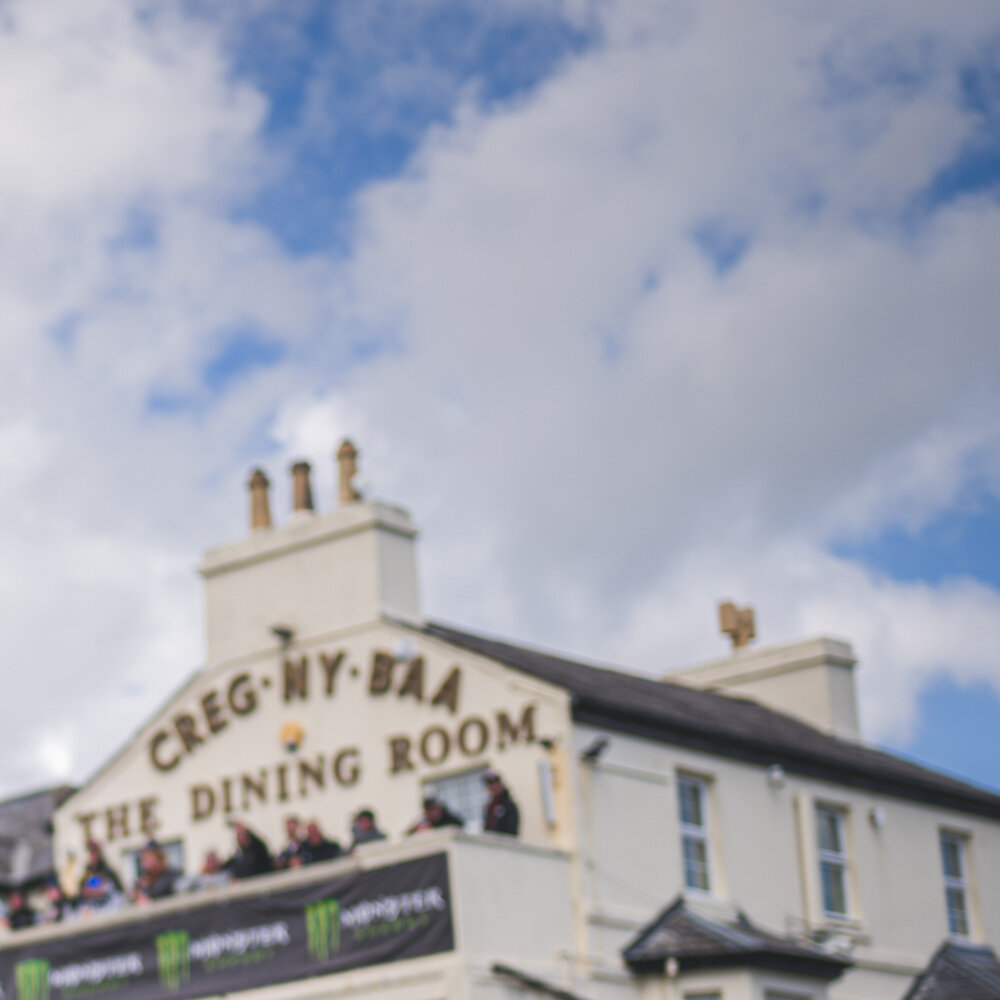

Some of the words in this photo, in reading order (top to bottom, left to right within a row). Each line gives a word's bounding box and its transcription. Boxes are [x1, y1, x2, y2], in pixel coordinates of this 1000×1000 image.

[77, 797, 161, 842] THE
[190, 748, 361, 824] DINING
[389, 704, 541, 775] ROOM
[149, 673, 258, 773] CREG
[282, 651, 346, 703] NY
[369, 651, 462, 715] BAA
